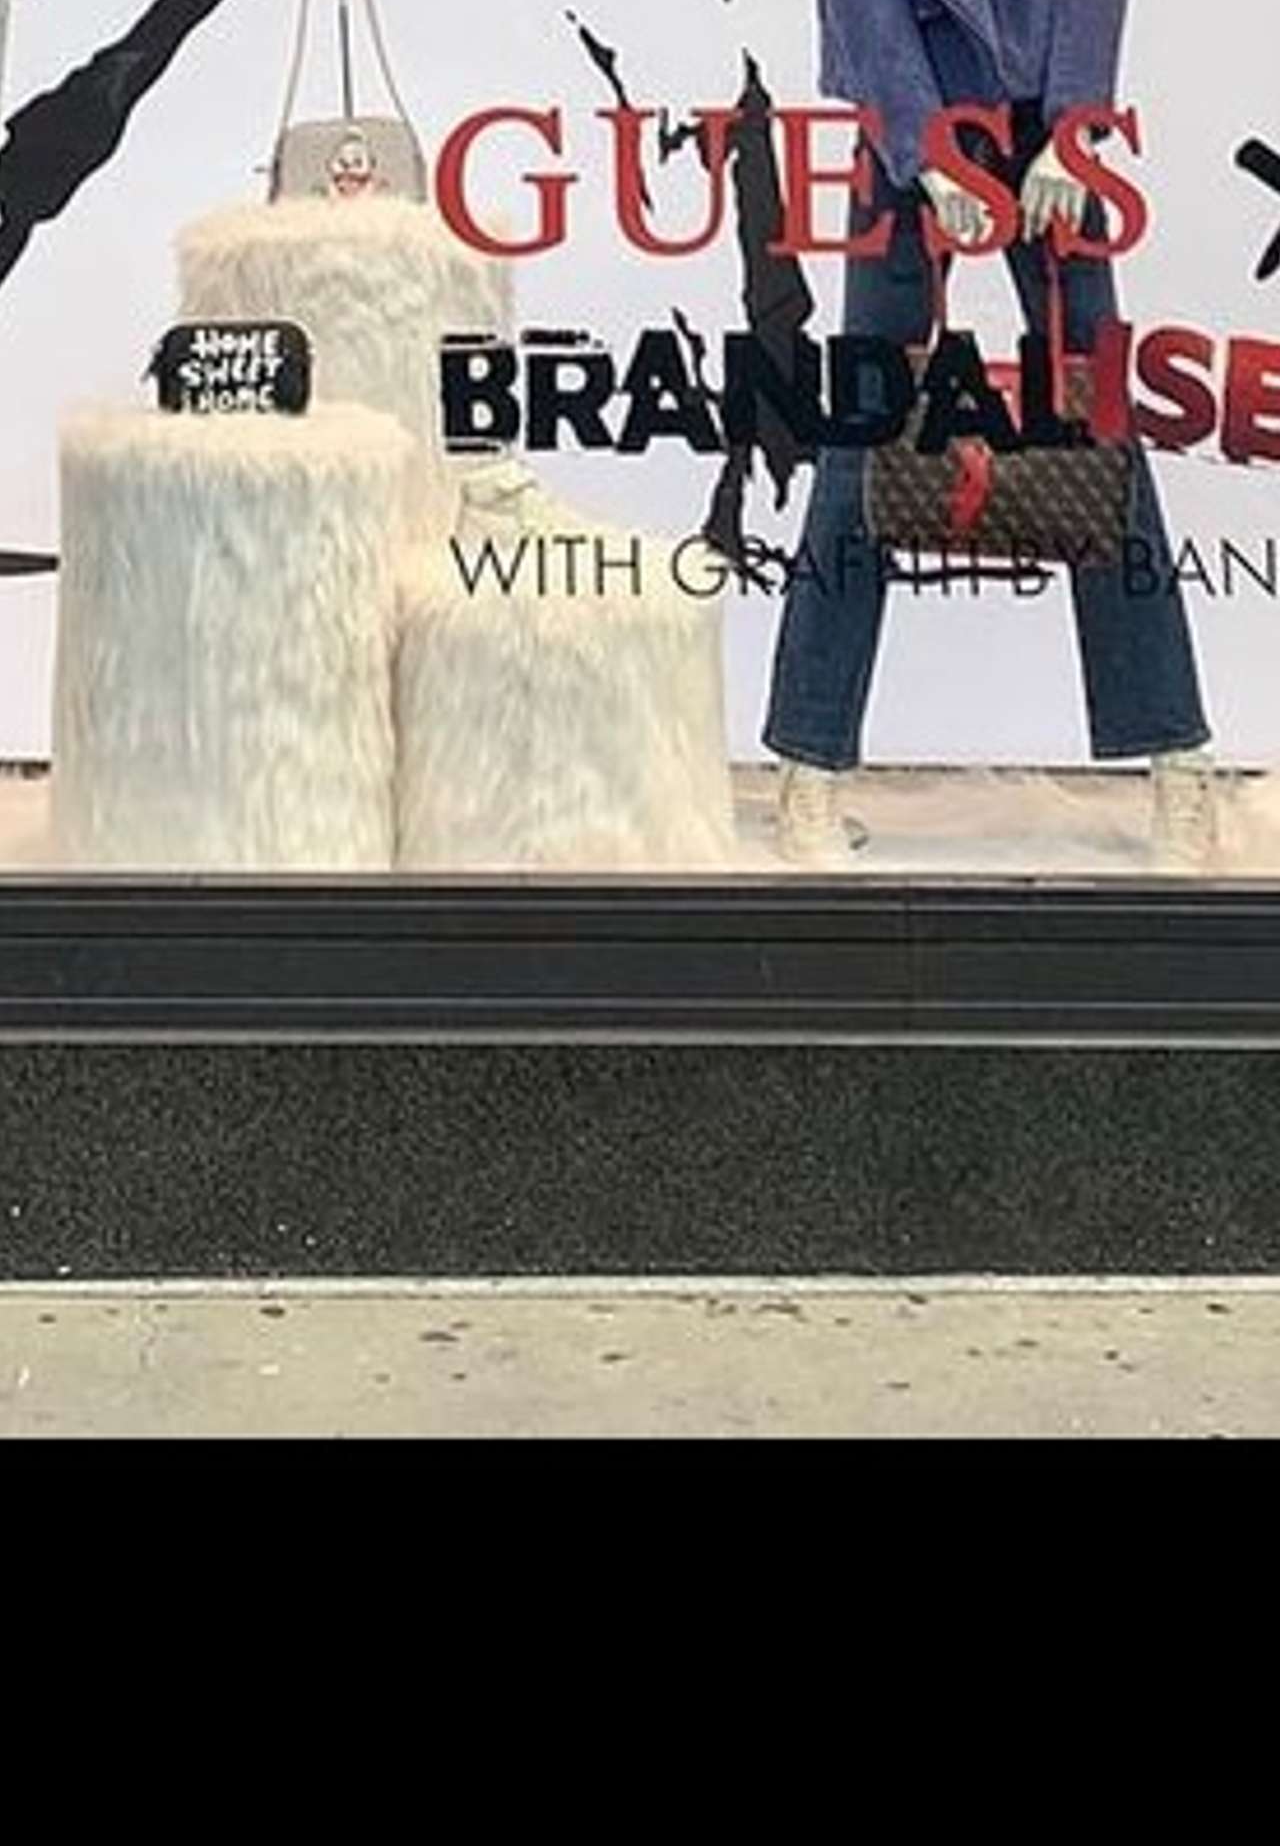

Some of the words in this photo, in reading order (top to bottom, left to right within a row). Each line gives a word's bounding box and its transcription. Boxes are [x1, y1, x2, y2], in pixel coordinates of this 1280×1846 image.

[435, 105, 1148, 259] GUESS
[448, 535, 642, 598] WITH
[1012, 536, 1092, 599] BY
